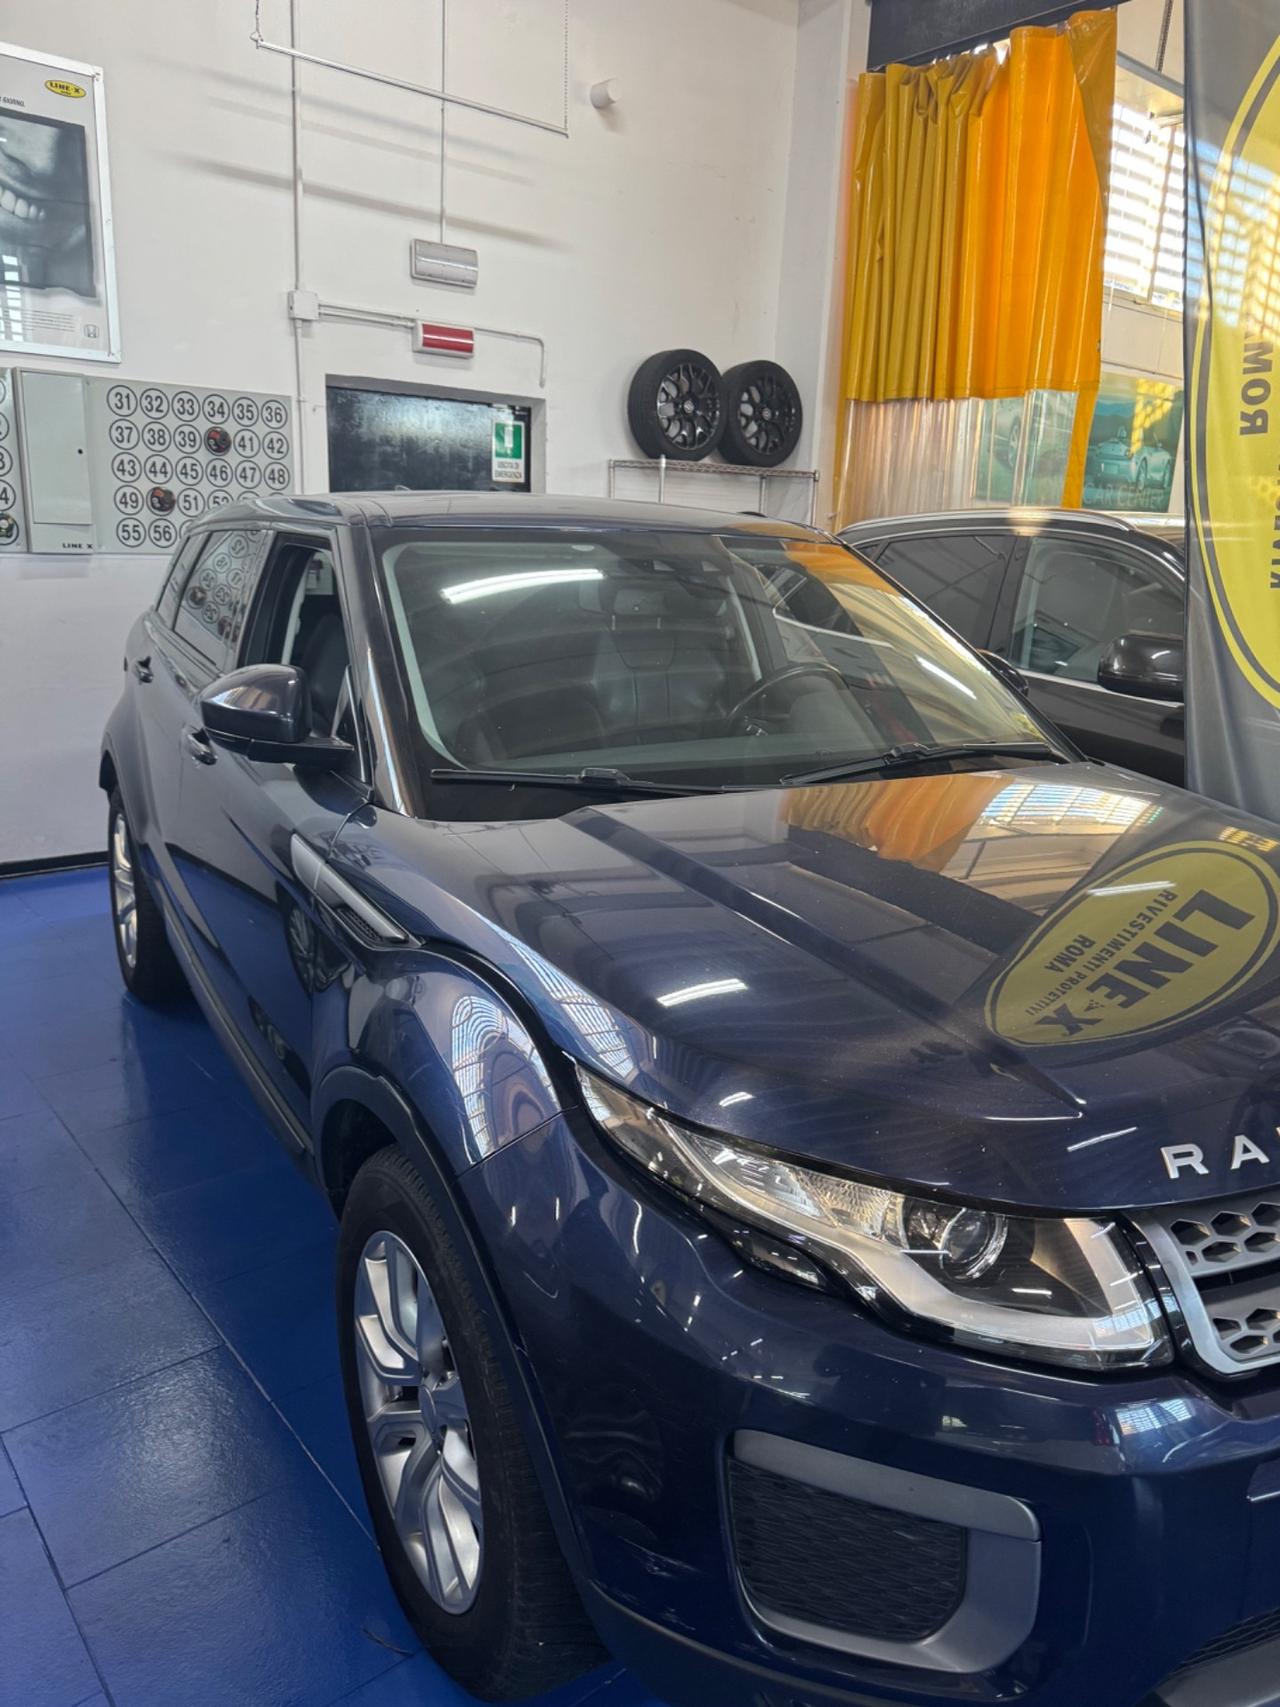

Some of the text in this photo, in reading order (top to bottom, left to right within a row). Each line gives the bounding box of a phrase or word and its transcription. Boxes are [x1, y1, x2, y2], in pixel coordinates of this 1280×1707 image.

[114, 392, 283, 423] 31 32 33 34 35 36
[116, 425, 196, 448] 37 38 39
[238, 435, 284, 454] 41 42
[117, 459, 286, 484] 43 44 45 46 47 48
[119, 492, 138, 509] 49
[182, 494, 199, 510] 51
[121, 524, 172, 542] 55 56
[1025, 889, 1179, 1016] RIVESTIMENTI PROTETTIVI
[1044, 934, 1097, 973] ROMA
[1160, 1127, 1280, 1179] RA
